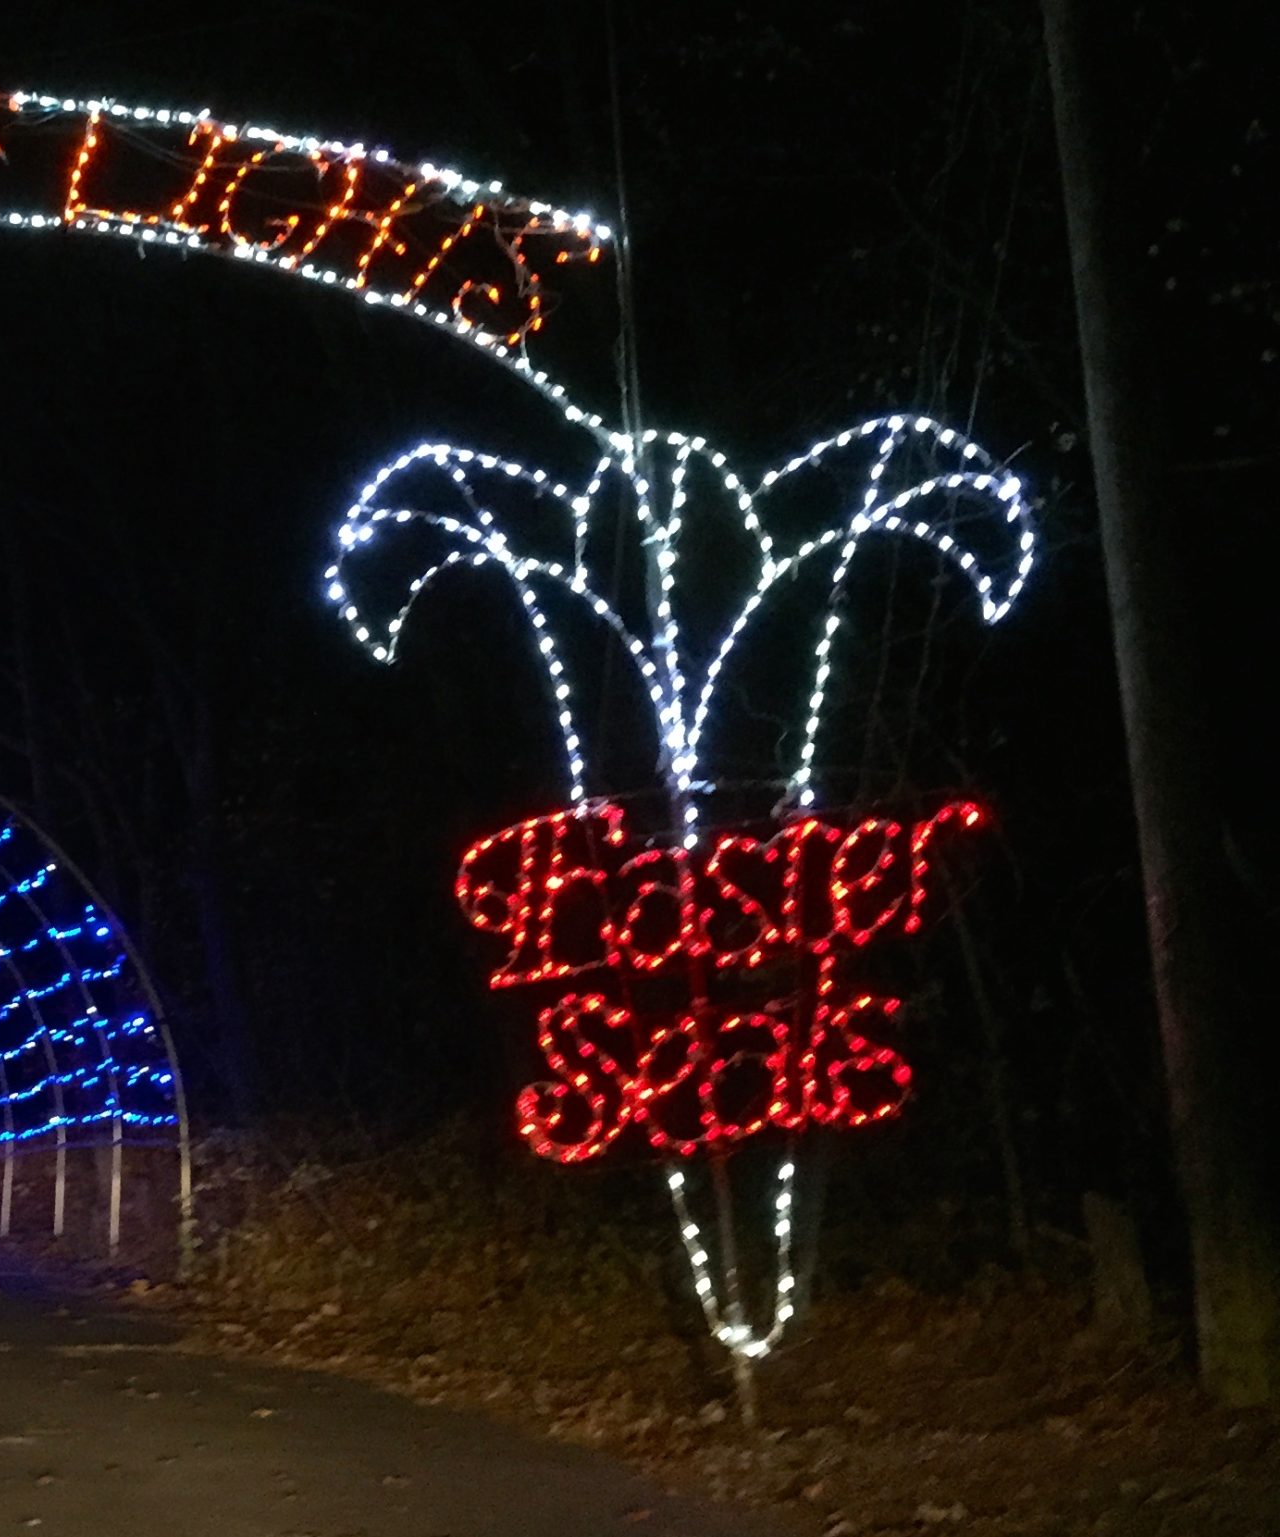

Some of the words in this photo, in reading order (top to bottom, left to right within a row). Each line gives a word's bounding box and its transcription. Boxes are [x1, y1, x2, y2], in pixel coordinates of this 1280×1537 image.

[63, 104, 603, 350] LIGHTS
[455, 800, 983, 990] Easter
[516, 956, 913, 1164] Seals
